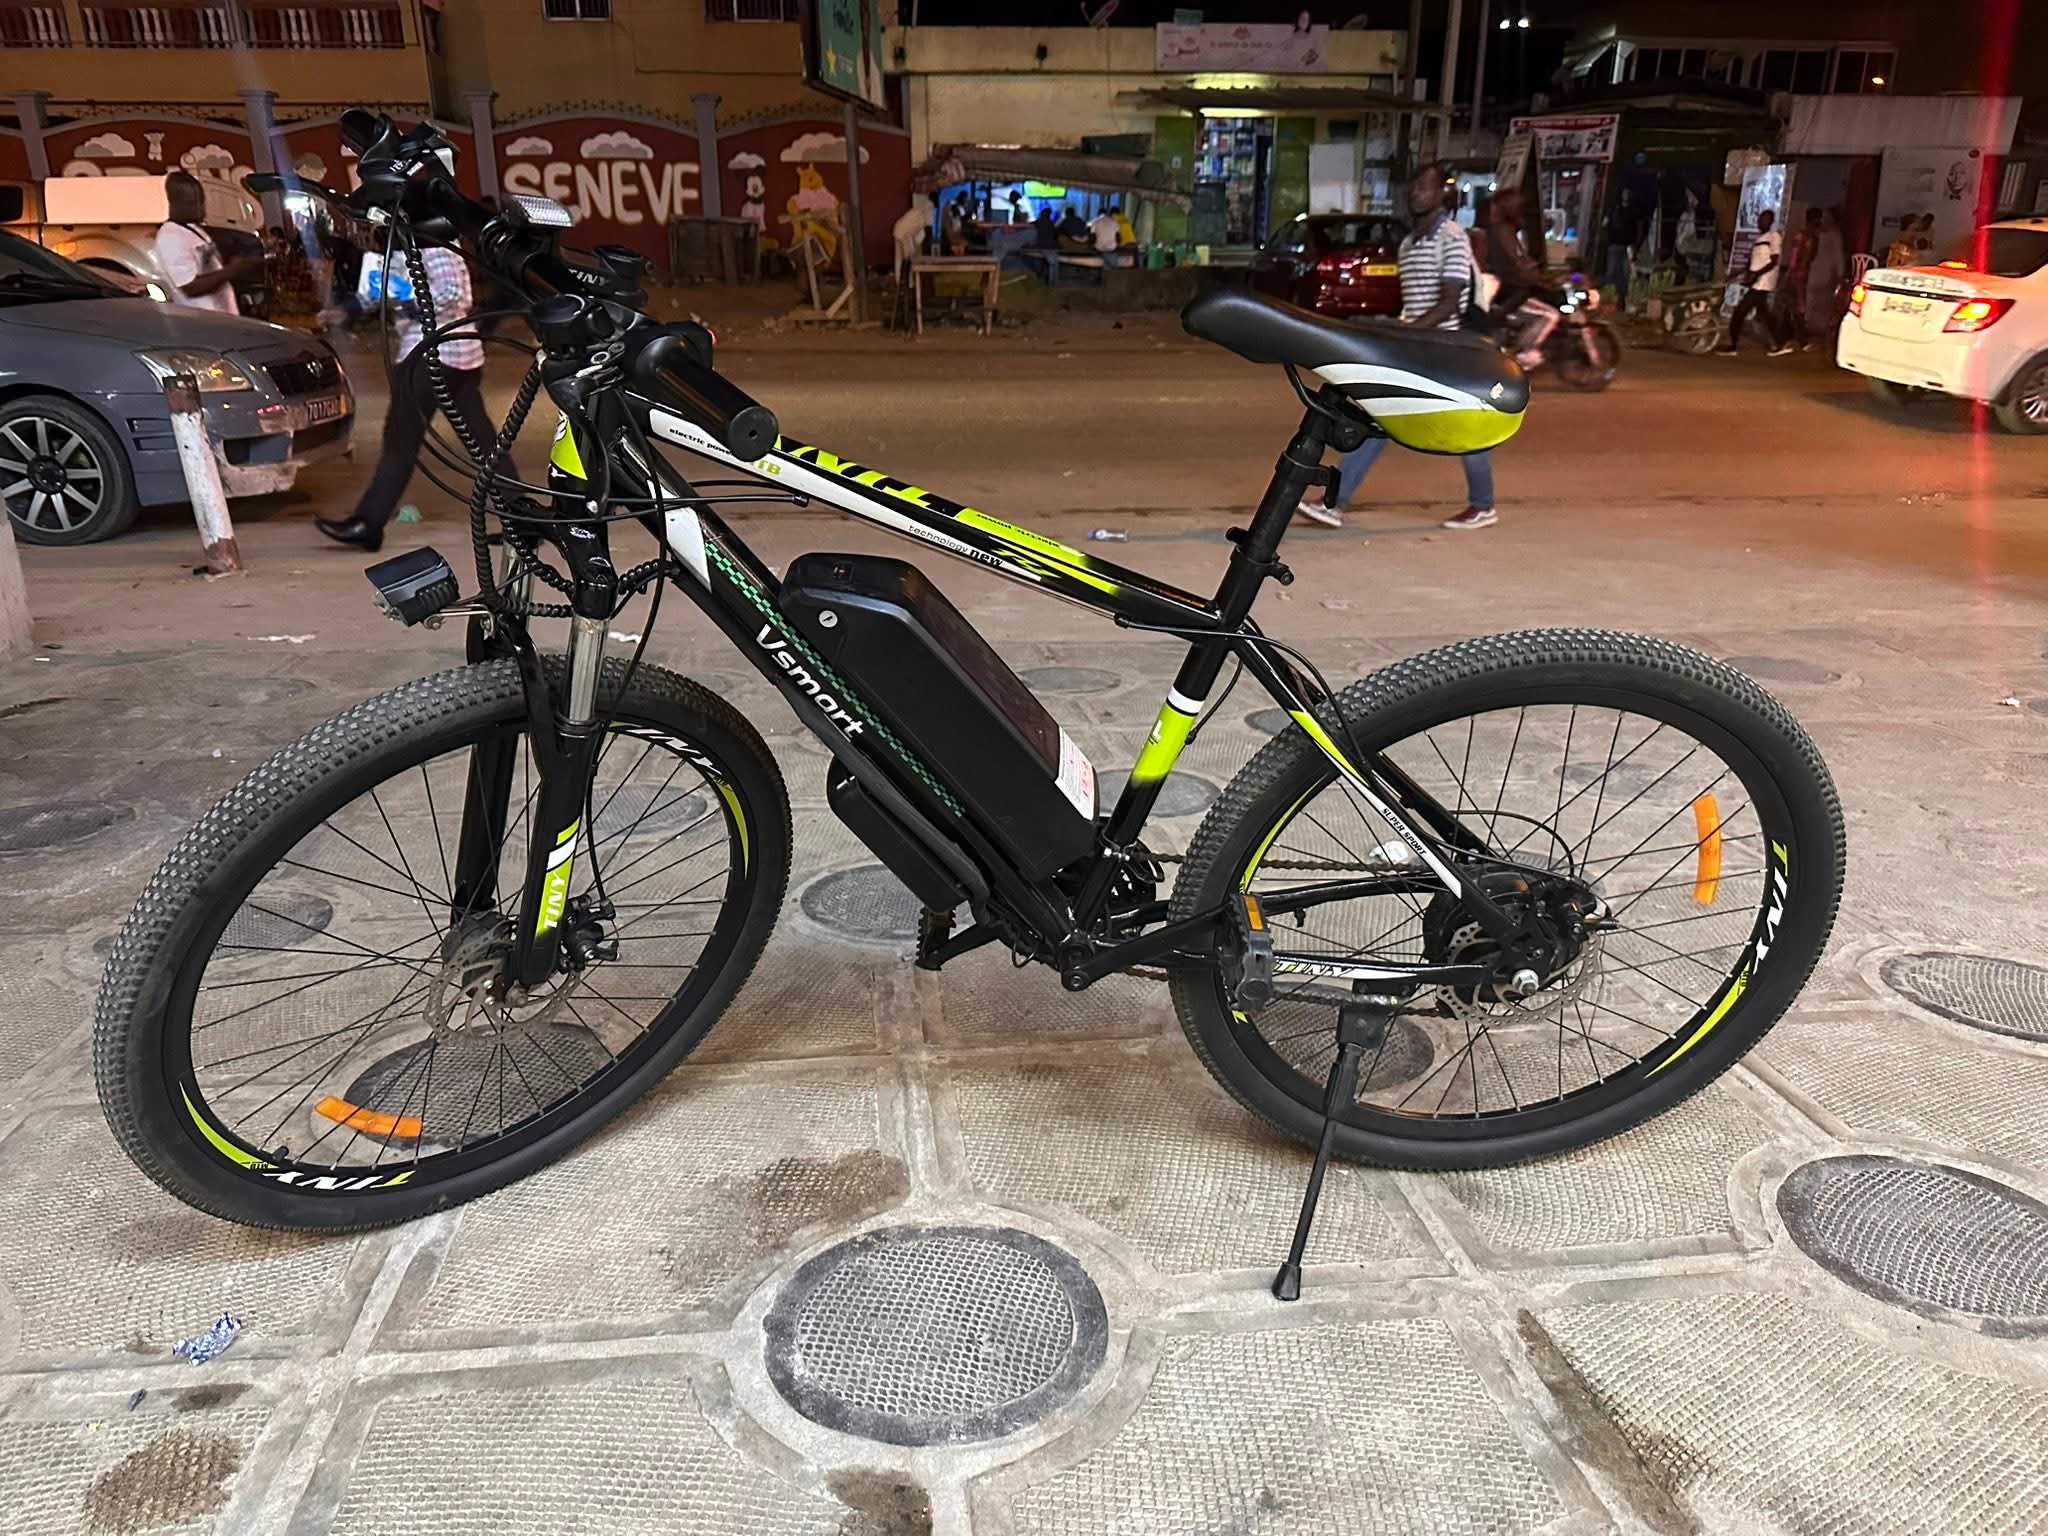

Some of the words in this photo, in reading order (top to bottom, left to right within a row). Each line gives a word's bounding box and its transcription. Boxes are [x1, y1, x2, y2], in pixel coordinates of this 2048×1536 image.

[669, 428, 705, 445] electric
[707, 441, 733, 455] powe
[908, 525, 969, 555] technology
[968, 548, 1003, 568] new
[756, 623, 864, 739] Vsmart
[1382, 807, 1406, 832] SUPER
[1403, 831, 1427, 855] SPORT
[543, 870, 565, 929] TINY
[1752, 839, 1789, 975] TINY
[1272, 960, 1352, 978] TINY
